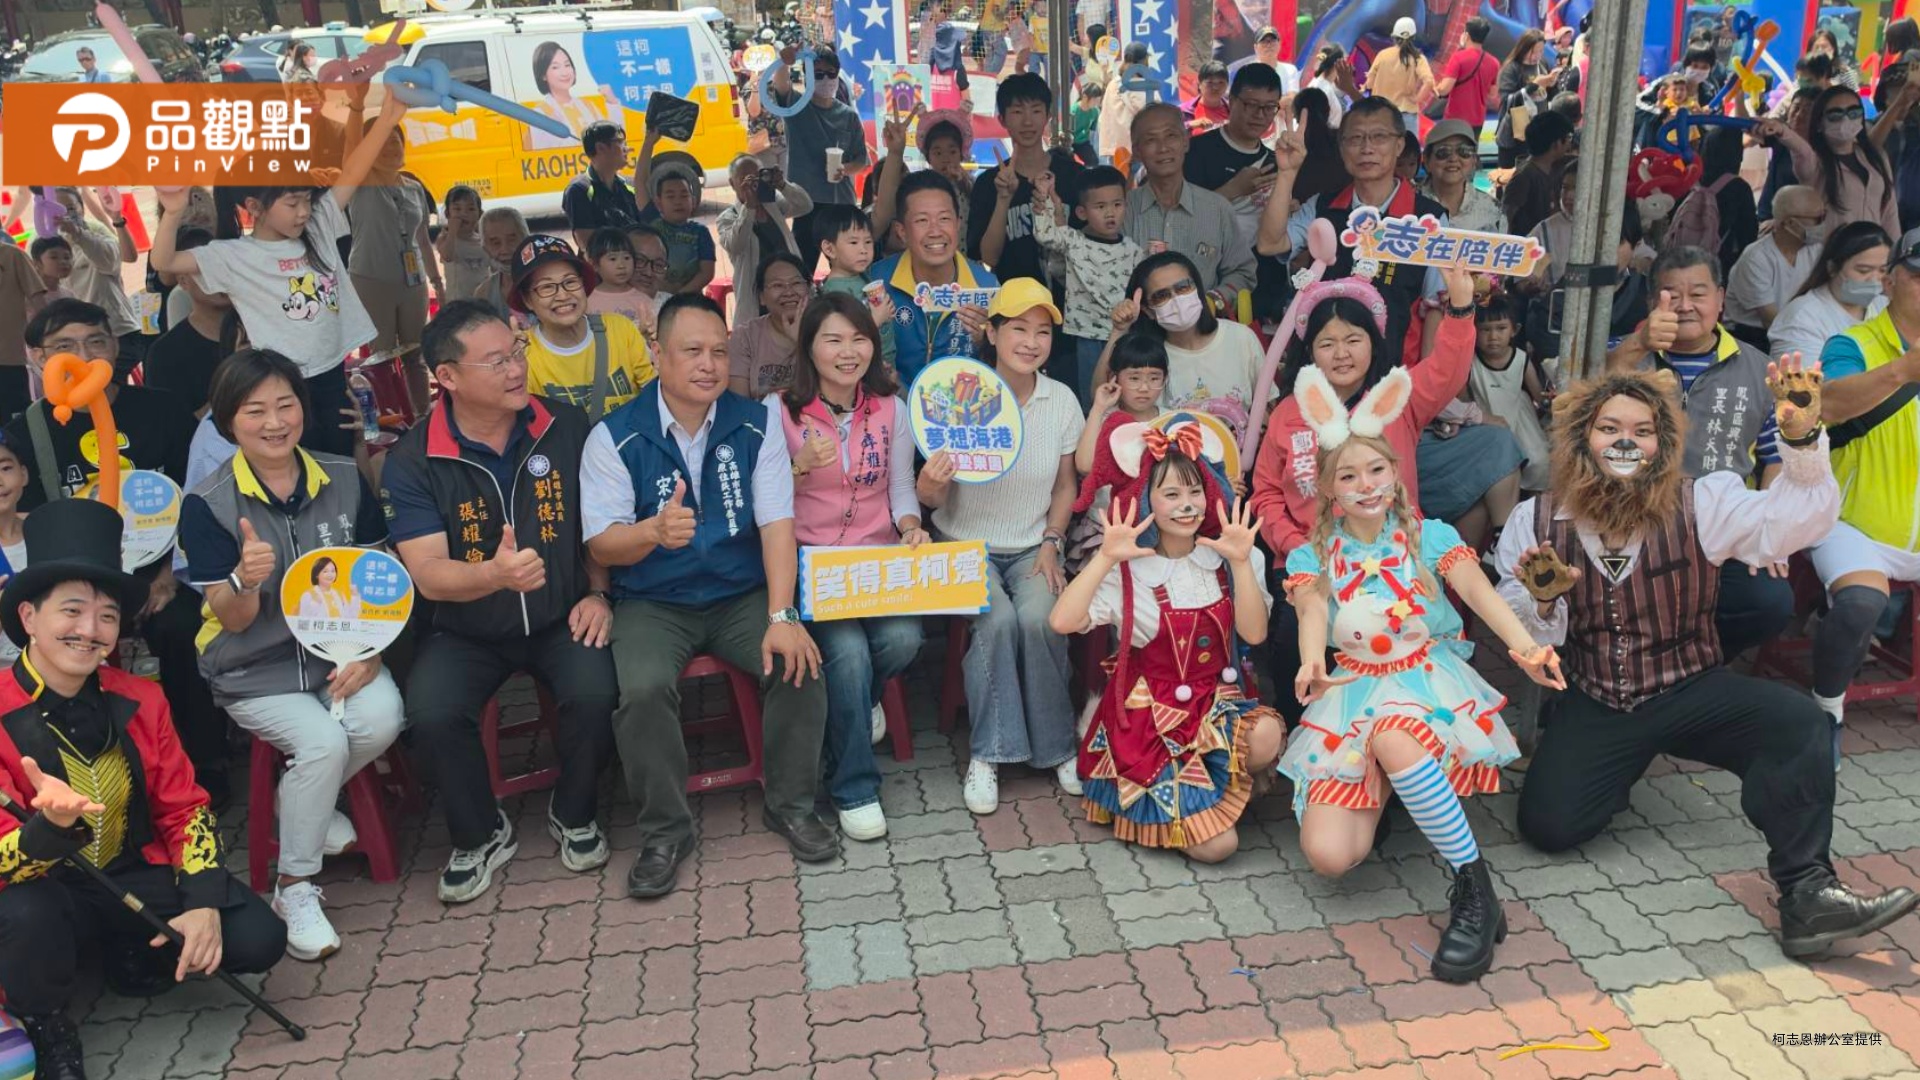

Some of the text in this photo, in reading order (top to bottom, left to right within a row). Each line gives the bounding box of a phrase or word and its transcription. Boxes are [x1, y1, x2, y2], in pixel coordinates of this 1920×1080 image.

[615, 38, 650, 57] 這柯
[619, 57, 672, 78] 不一樣
[1376, 219, 1526, 269] 志在陪伴
[934, 287, 997, 309] 志在陪
[924, 425, 1013, 451] 夢想海港
[477, 496, 489, 520] 主任
[534, 478, 559, 543] 劉德林
[815, 548, 983, 602] 笑得真柯愛
[313, 621, 351, 631] 柯志恩
